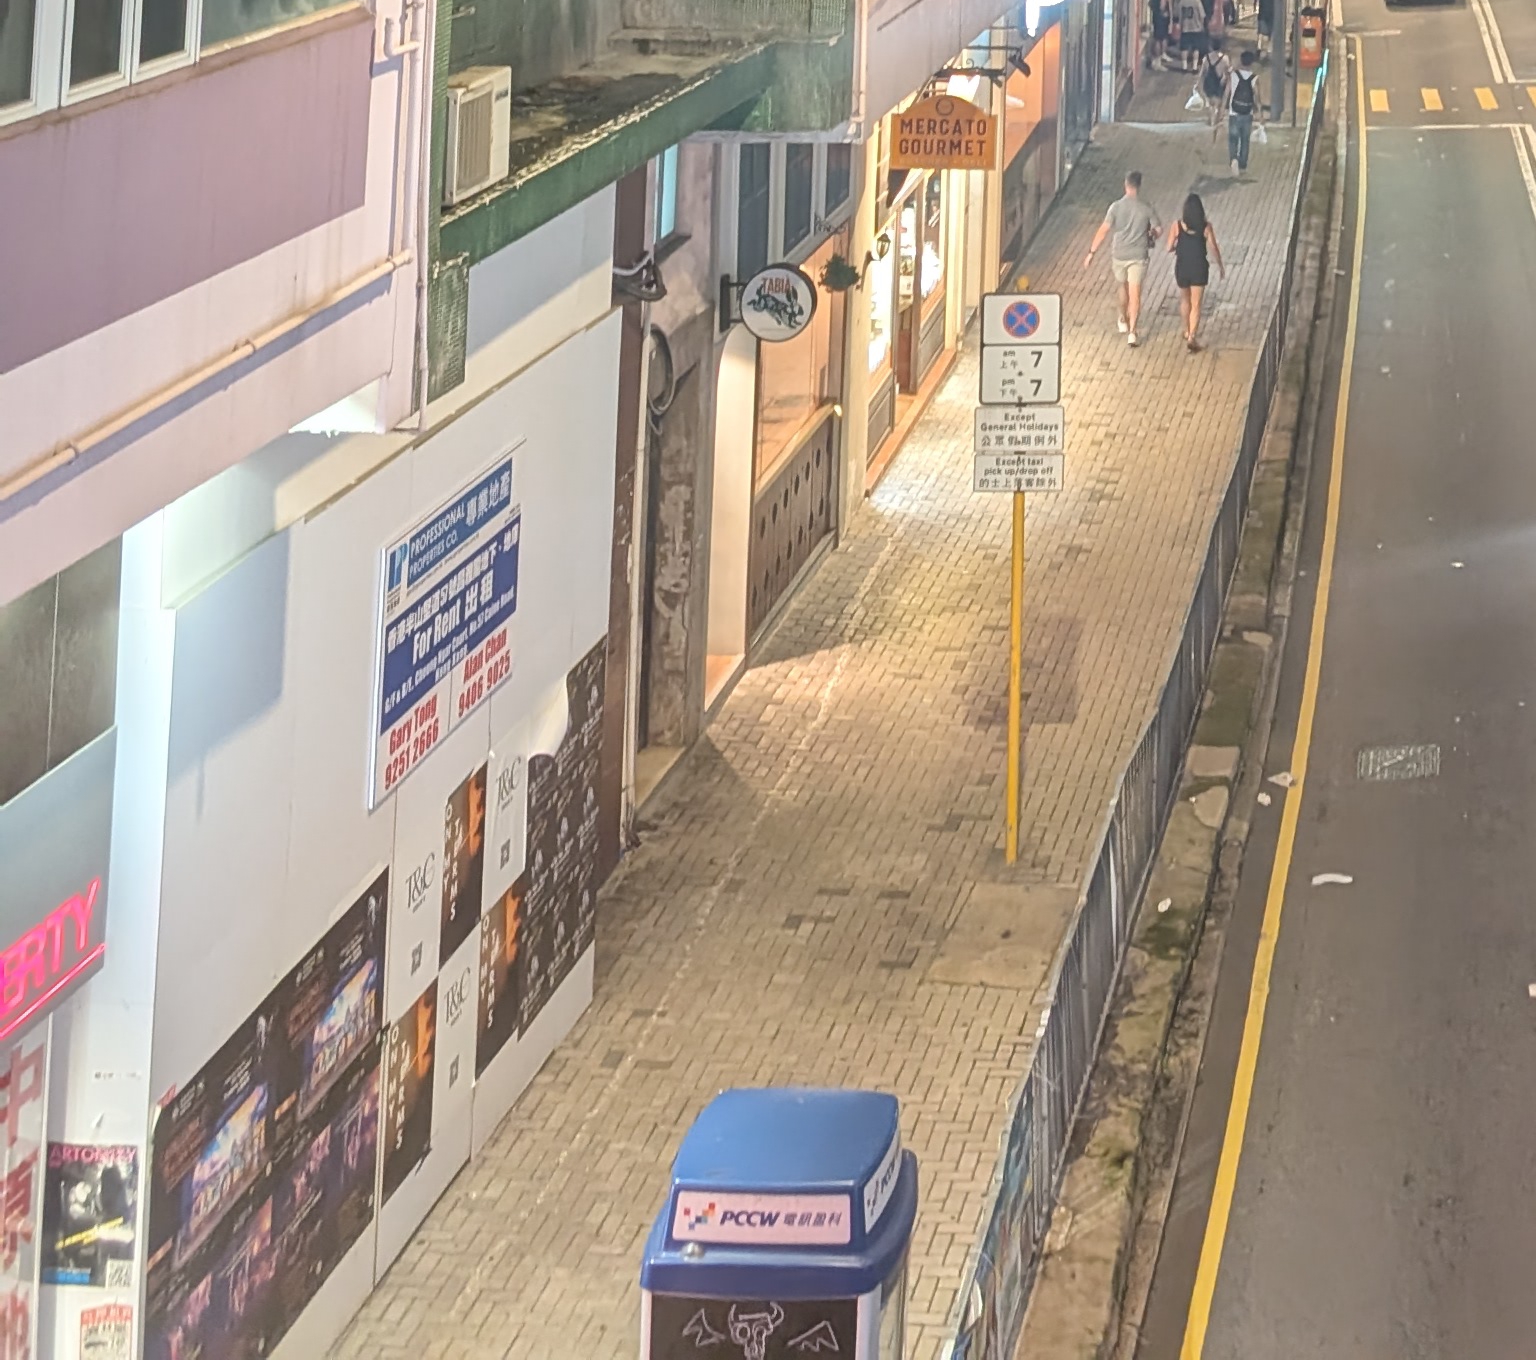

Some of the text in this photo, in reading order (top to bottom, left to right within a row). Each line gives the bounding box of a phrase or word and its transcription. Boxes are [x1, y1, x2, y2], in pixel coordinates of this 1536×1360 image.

[900, 119, 987, 135] MERCATO
[899, 139, 986, 156] GOURMET
[1031, 351, 1042, 368] 7
[1030, 379, 1042, 397] 7
[1004, 412, 1036, 422] Except
[981, 422, 1059, 433] General Holidays
[996, 457, 1043, 467] Except taxi
[984, 466, 1053, 477] pick up/drop off
[410, 503, 465, 559] PROFESSIONAL
[409, 541, 444, 579] PROPERTIES
[412, 623, 432, 665] For
[433, 599, 460, 646] Rent
[464, 570, 493, 619] 出租
[463, 626, 506, 683] Alan Chan
[458, 651, 510, 717] 9406 9025
[389, 693, 437, 756] Gary Tong
[384, 719, 438, 790] 9251 2666
[720, 1210, 778, 1227] PCCW
